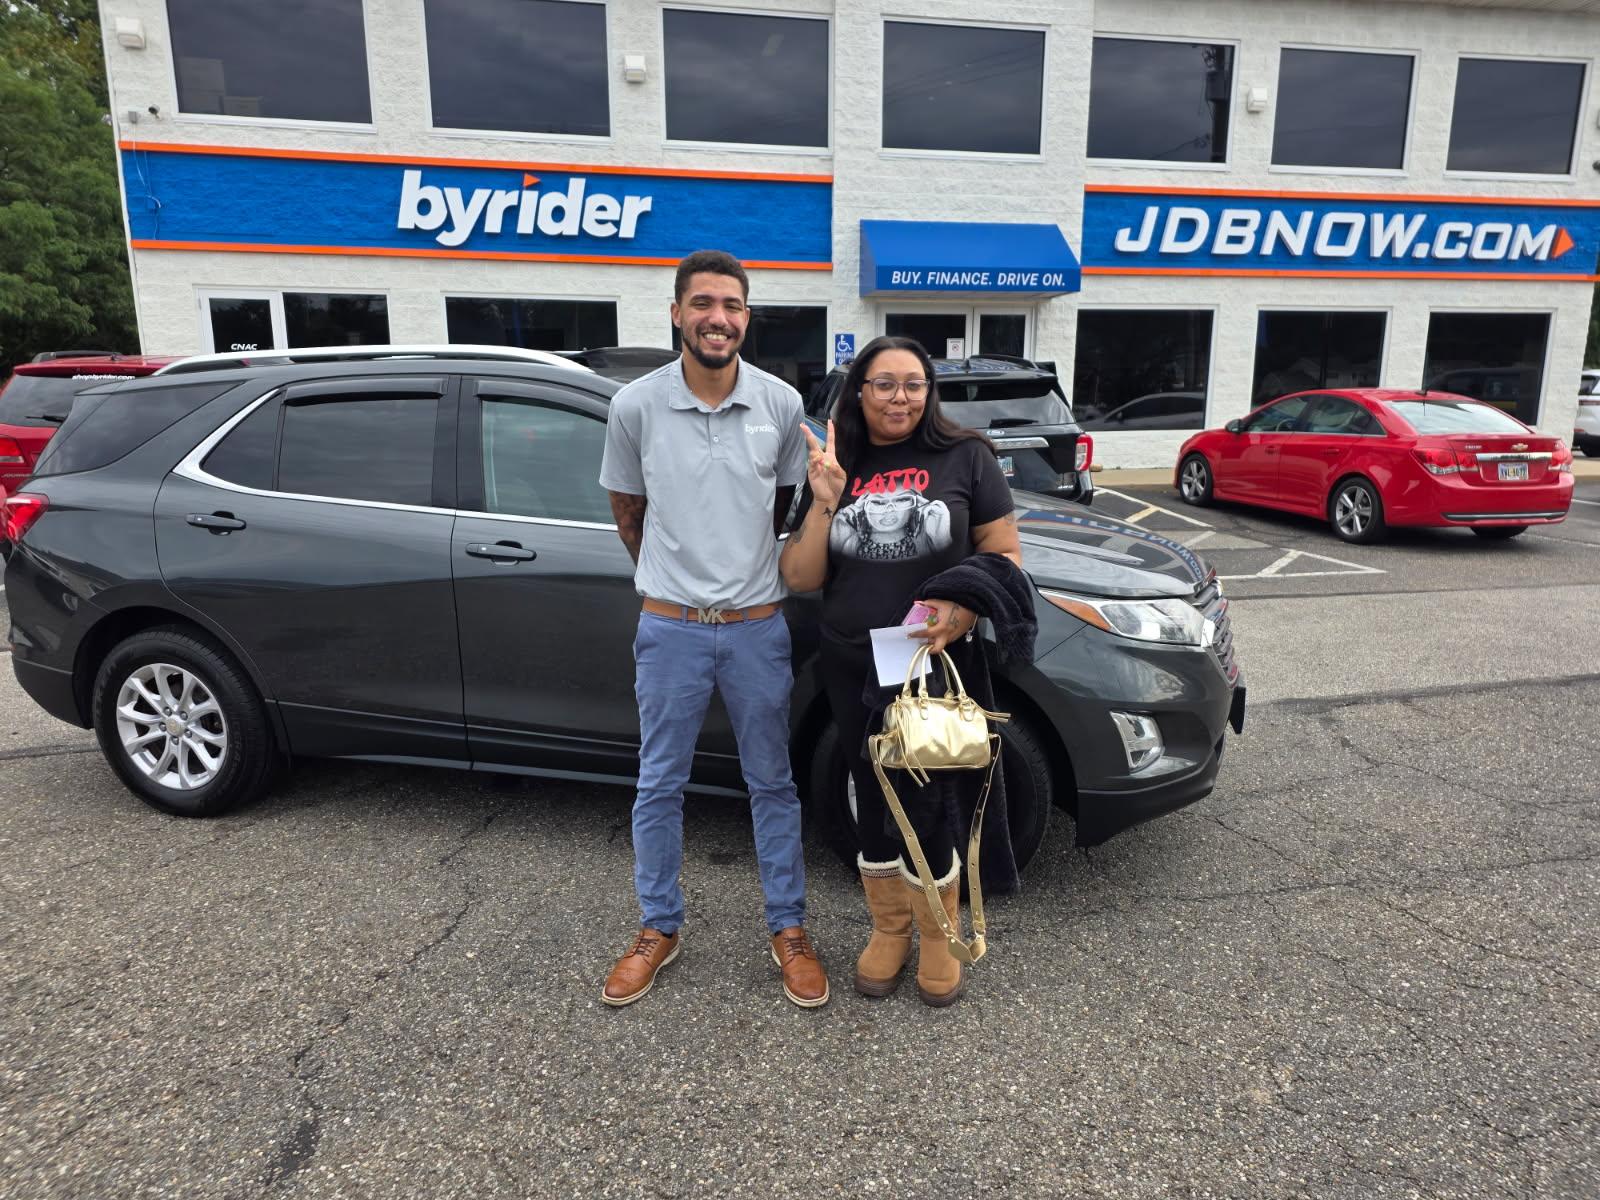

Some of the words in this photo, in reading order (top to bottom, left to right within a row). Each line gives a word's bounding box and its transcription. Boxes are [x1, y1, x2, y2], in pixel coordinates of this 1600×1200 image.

[397, 169, 652, 247] byrider
[1114, 206, 1557, 261] JDBNOW.COM
[892, 271, 922, 285] BUY.
[927, 271, 992, 286] FINANCE.
[997, 273, 1038, 286] DRIVE
[1042, 273, 1066, 286] ON.
[231, 343, 258, 351] CNAC
[850, 467, 930, 497] LATTO
[698, 607, 727, 624] MK
